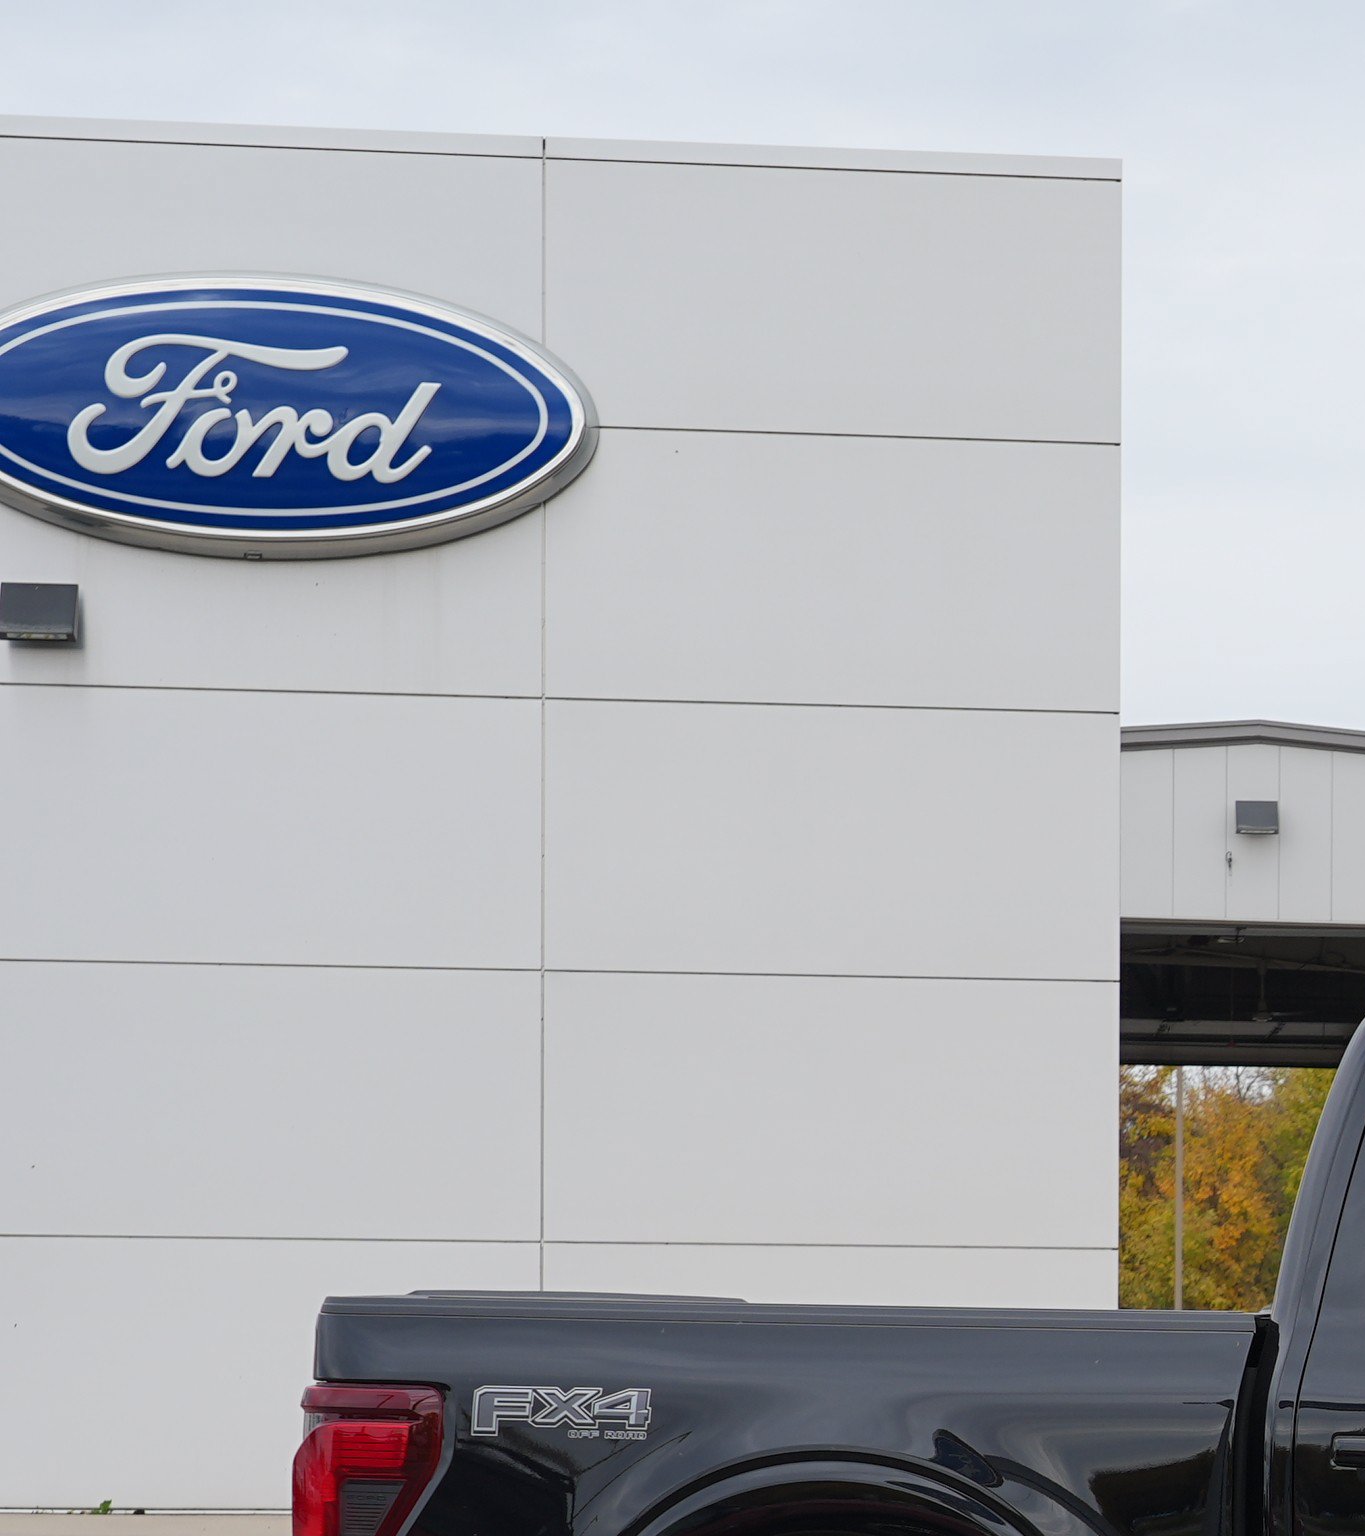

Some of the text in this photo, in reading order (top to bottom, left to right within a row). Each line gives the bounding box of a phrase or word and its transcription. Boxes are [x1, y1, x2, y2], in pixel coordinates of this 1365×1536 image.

[67, 333, 441, 484] Ford
[471, 1385, 653, 1437] FX4
[568, 1430, 648, 1440] OFF ROAD
